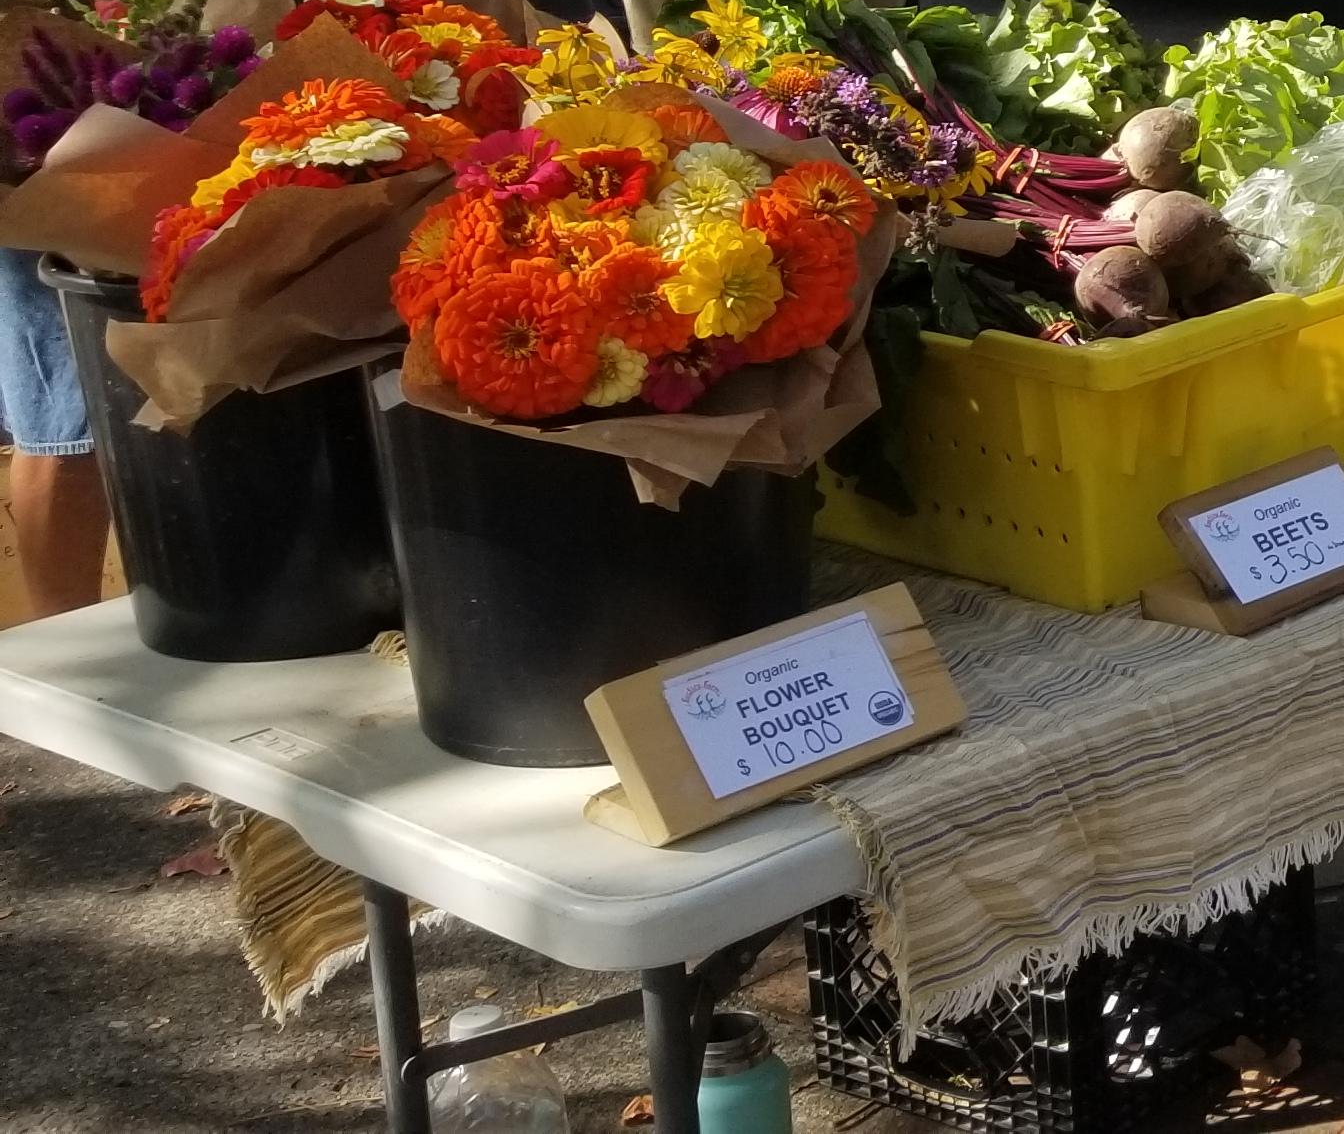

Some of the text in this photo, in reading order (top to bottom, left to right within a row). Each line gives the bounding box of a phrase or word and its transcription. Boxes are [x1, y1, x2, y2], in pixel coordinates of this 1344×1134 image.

[1253, 497, 1301, 521] Organic
[1252, 512, 1329, 553] BEETS
[744, 657, 799, 685] Organic
[736, 671, 834, 718] FLOWER
[742, 692, 850, 746] BOUQUET
[763, 720, 842, 767] 10.00
